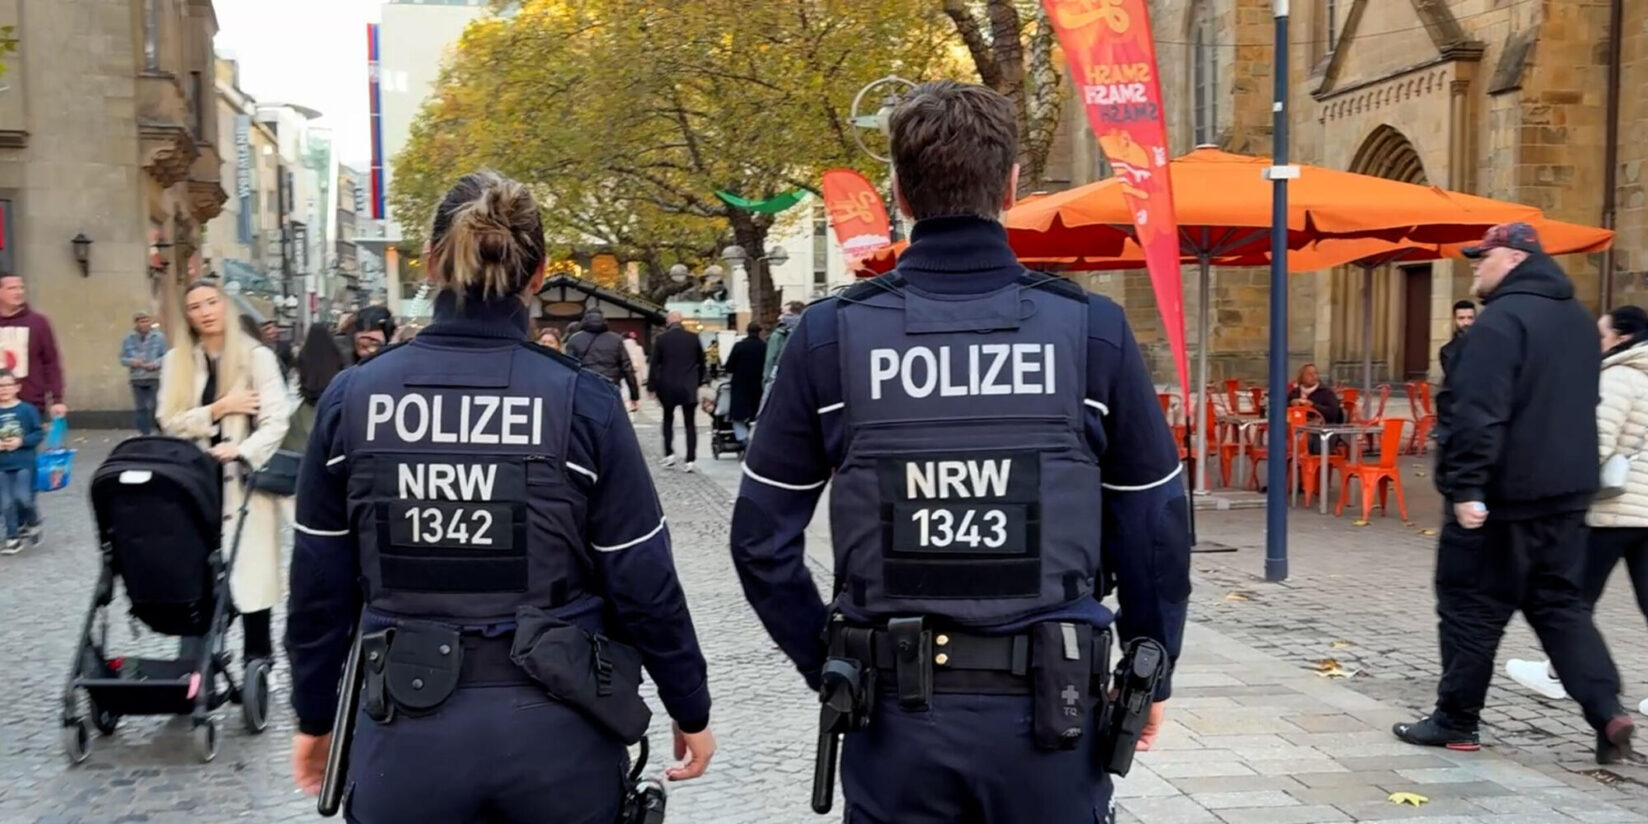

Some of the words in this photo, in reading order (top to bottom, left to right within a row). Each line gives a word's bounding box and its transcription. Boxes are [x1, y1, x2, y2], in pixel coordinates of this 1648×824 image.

[871, 343, 1056, 399] POLIZEI
[366, 393, 543, 445] POLIZEI
[398, 463, 497, 501] NRW
[906, 459, 1012, 499] NRW
[405, 507, 493, 545] 1342
[912, 508, 1007, 548] 1343
[1063, 706, 1078, 717] TQ
